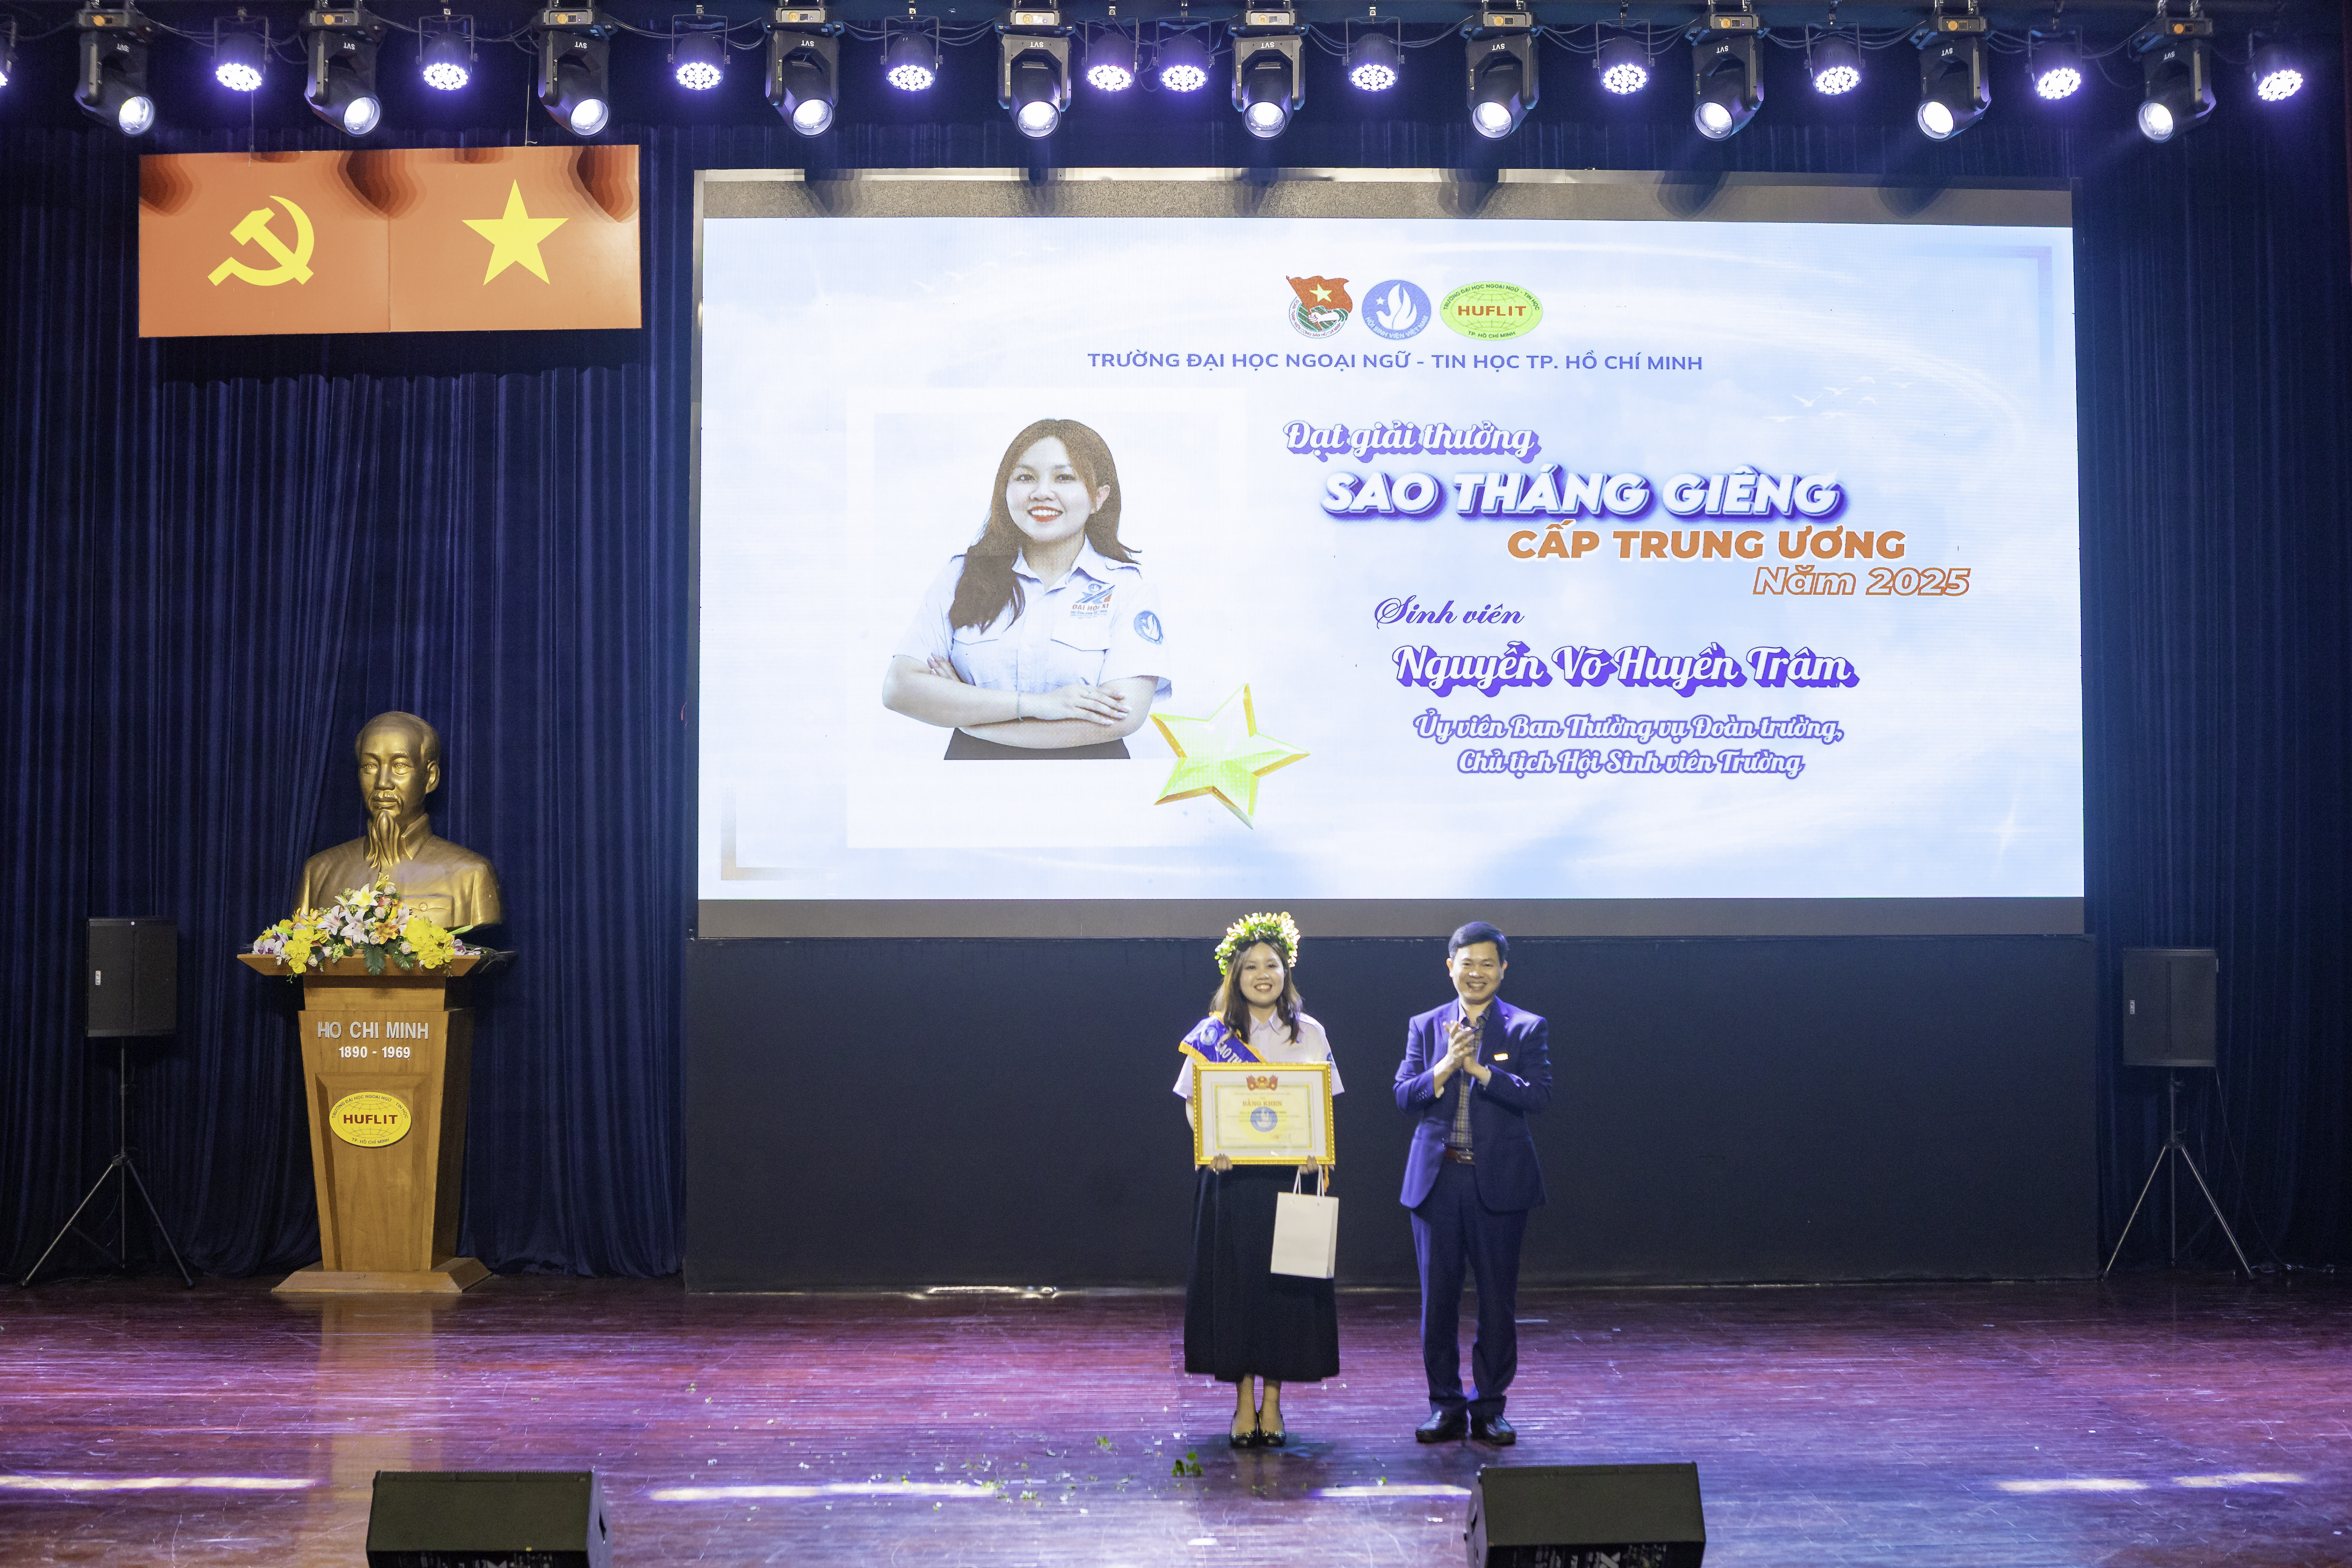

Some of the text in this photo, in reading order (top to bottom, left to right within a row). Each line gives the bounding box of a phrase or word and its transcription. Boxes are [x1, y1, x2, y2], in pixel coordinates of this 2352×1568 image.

[1458, 305, 1527, 316] HUFLIT
[1087, 349, 1179, 368] TRƯỜNG
[1186, 353, 1224, 371] ĐẠI
[1233, 353, 1279, 371] HỌC
[1286, 353, 1356, 371] NGOẠI
[1363, 350, 1410, 368] NGỮ
[1431, 354, 1466, 369] TIN
[1474, 354, 1519, 372] HỌC
[1526, 355, 1558, 369] TP.
[1566, 350, 1597, 369] HỒ
[1604, 353, 1640, 370] CHÍ
[1648, 355, 1703, 371] MINH
[1283, 420, 1538, 461] Đạt giải thưởng
[1321, 464, 1841, 518] SAO THÁNG GIÊNG
[1508, 519, 1906, 559] CẤP TRUNG ƯƠNG
[1753, 565, 1972, 596] Năm 2025
[1374, 594, 1525, 629] Sinh viên
[1392, 641, 1857, 693] Nguyễn Võ Huyền Trâm
[1413, 708, 1844, 744] Ủy viên Ban Thường vụ Đoàn trường,
[1458, 749, 1805, 779] Chủ tịch Hội Sinh viên Trường
[317, 1021, 429, 1040] HO CHI MINH
[339, 1046, 368, 1058] 1890
[381, 1046, 411, 1059] 1969
[343, 1114, 398, 1124] HUFLIT
